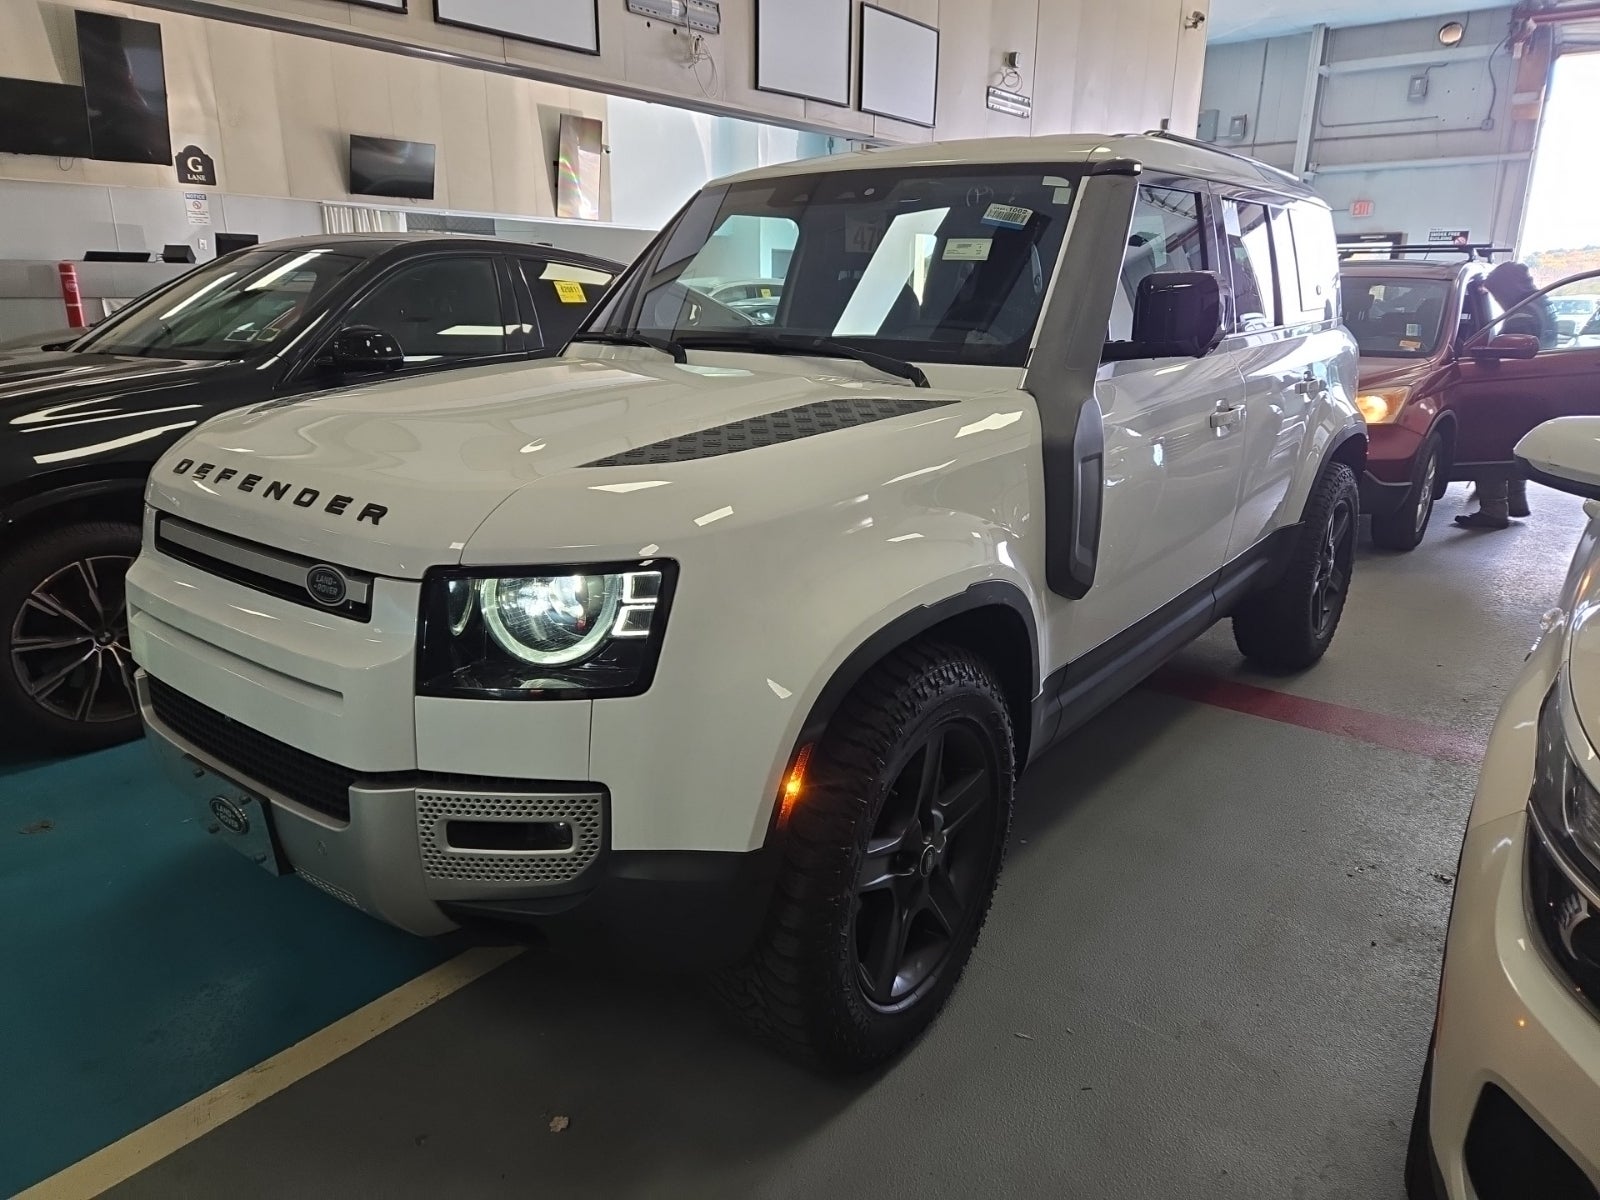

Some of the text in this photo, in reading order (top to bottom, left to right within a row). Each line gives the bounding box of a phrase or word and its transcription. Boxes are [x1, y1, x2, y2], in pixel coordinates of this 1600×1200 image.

[187, 156, 203, 173] G
[187, 173, 207, 182] LANE
[173, 458, 388, 525] DEFENDER
